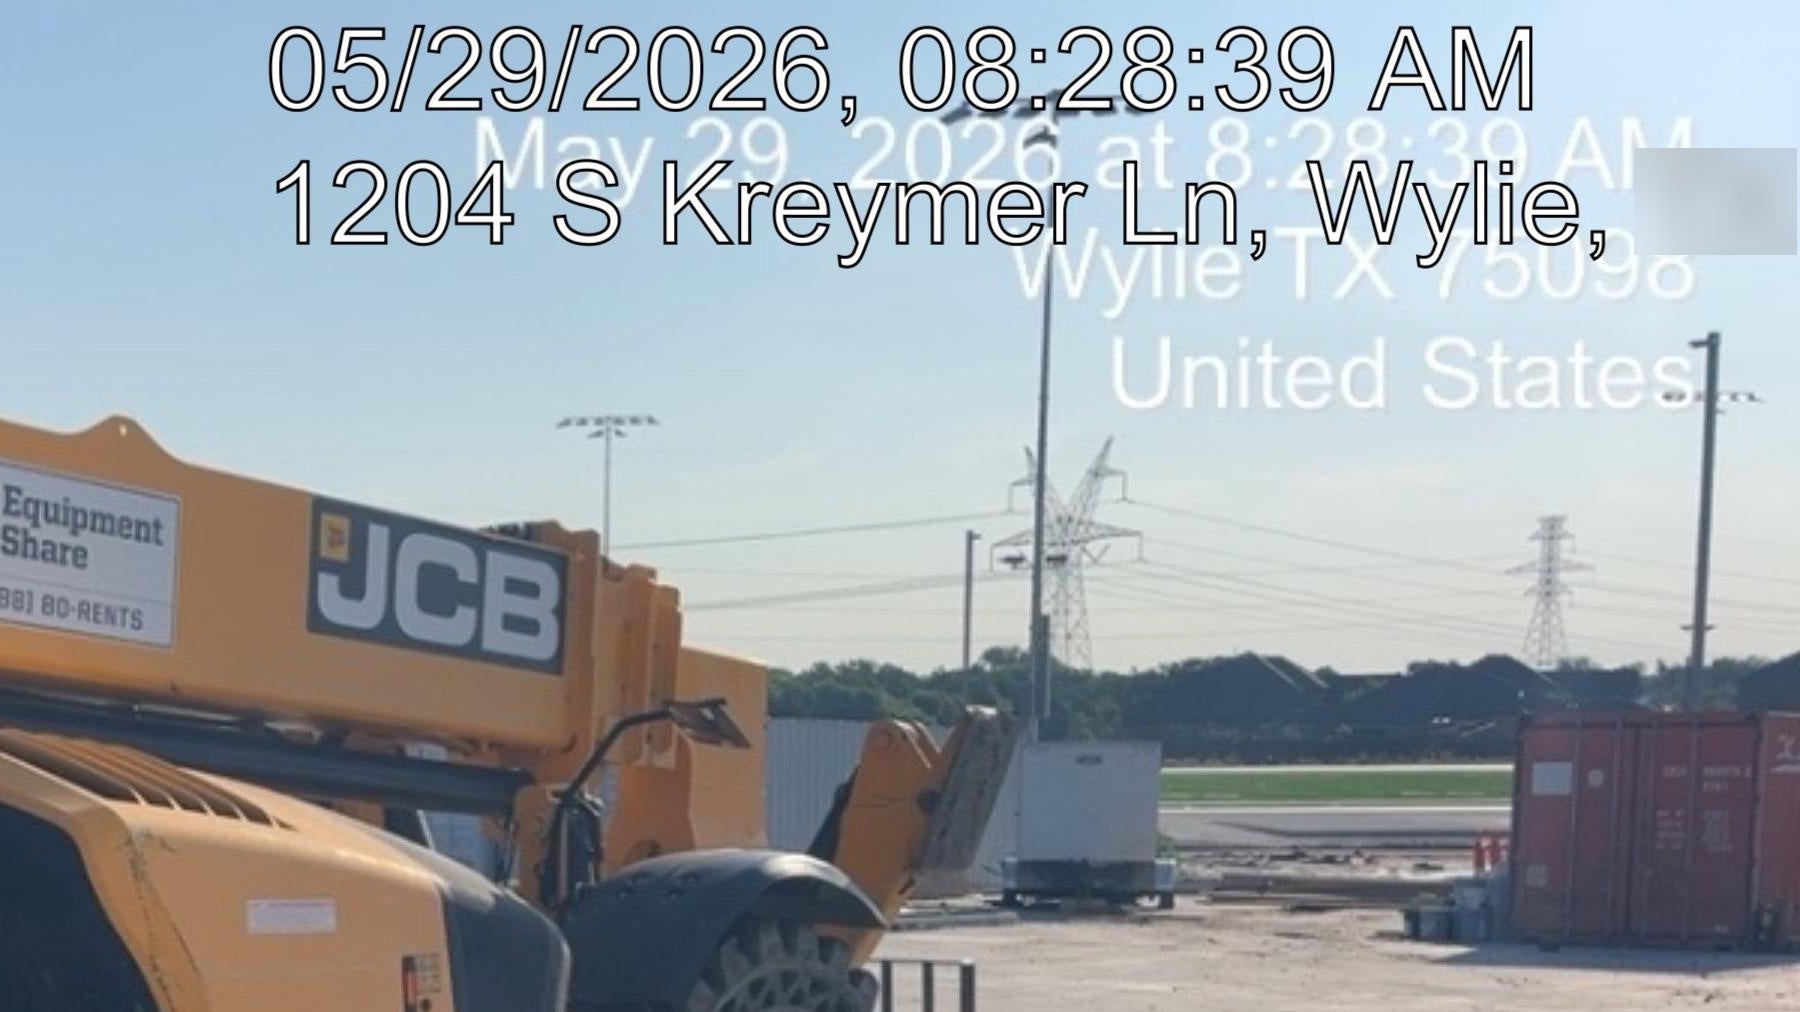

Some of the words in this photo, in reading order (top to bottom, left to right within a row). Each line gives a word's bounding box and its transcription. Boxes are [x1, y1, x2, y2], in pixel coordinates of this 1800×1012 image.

[2, 483, 165, 547] Equipment
[0, 523, 89, 570] Share
[41, 593, 144, 631] 80-RENTS
[316, 521, 562, 662] JCB
